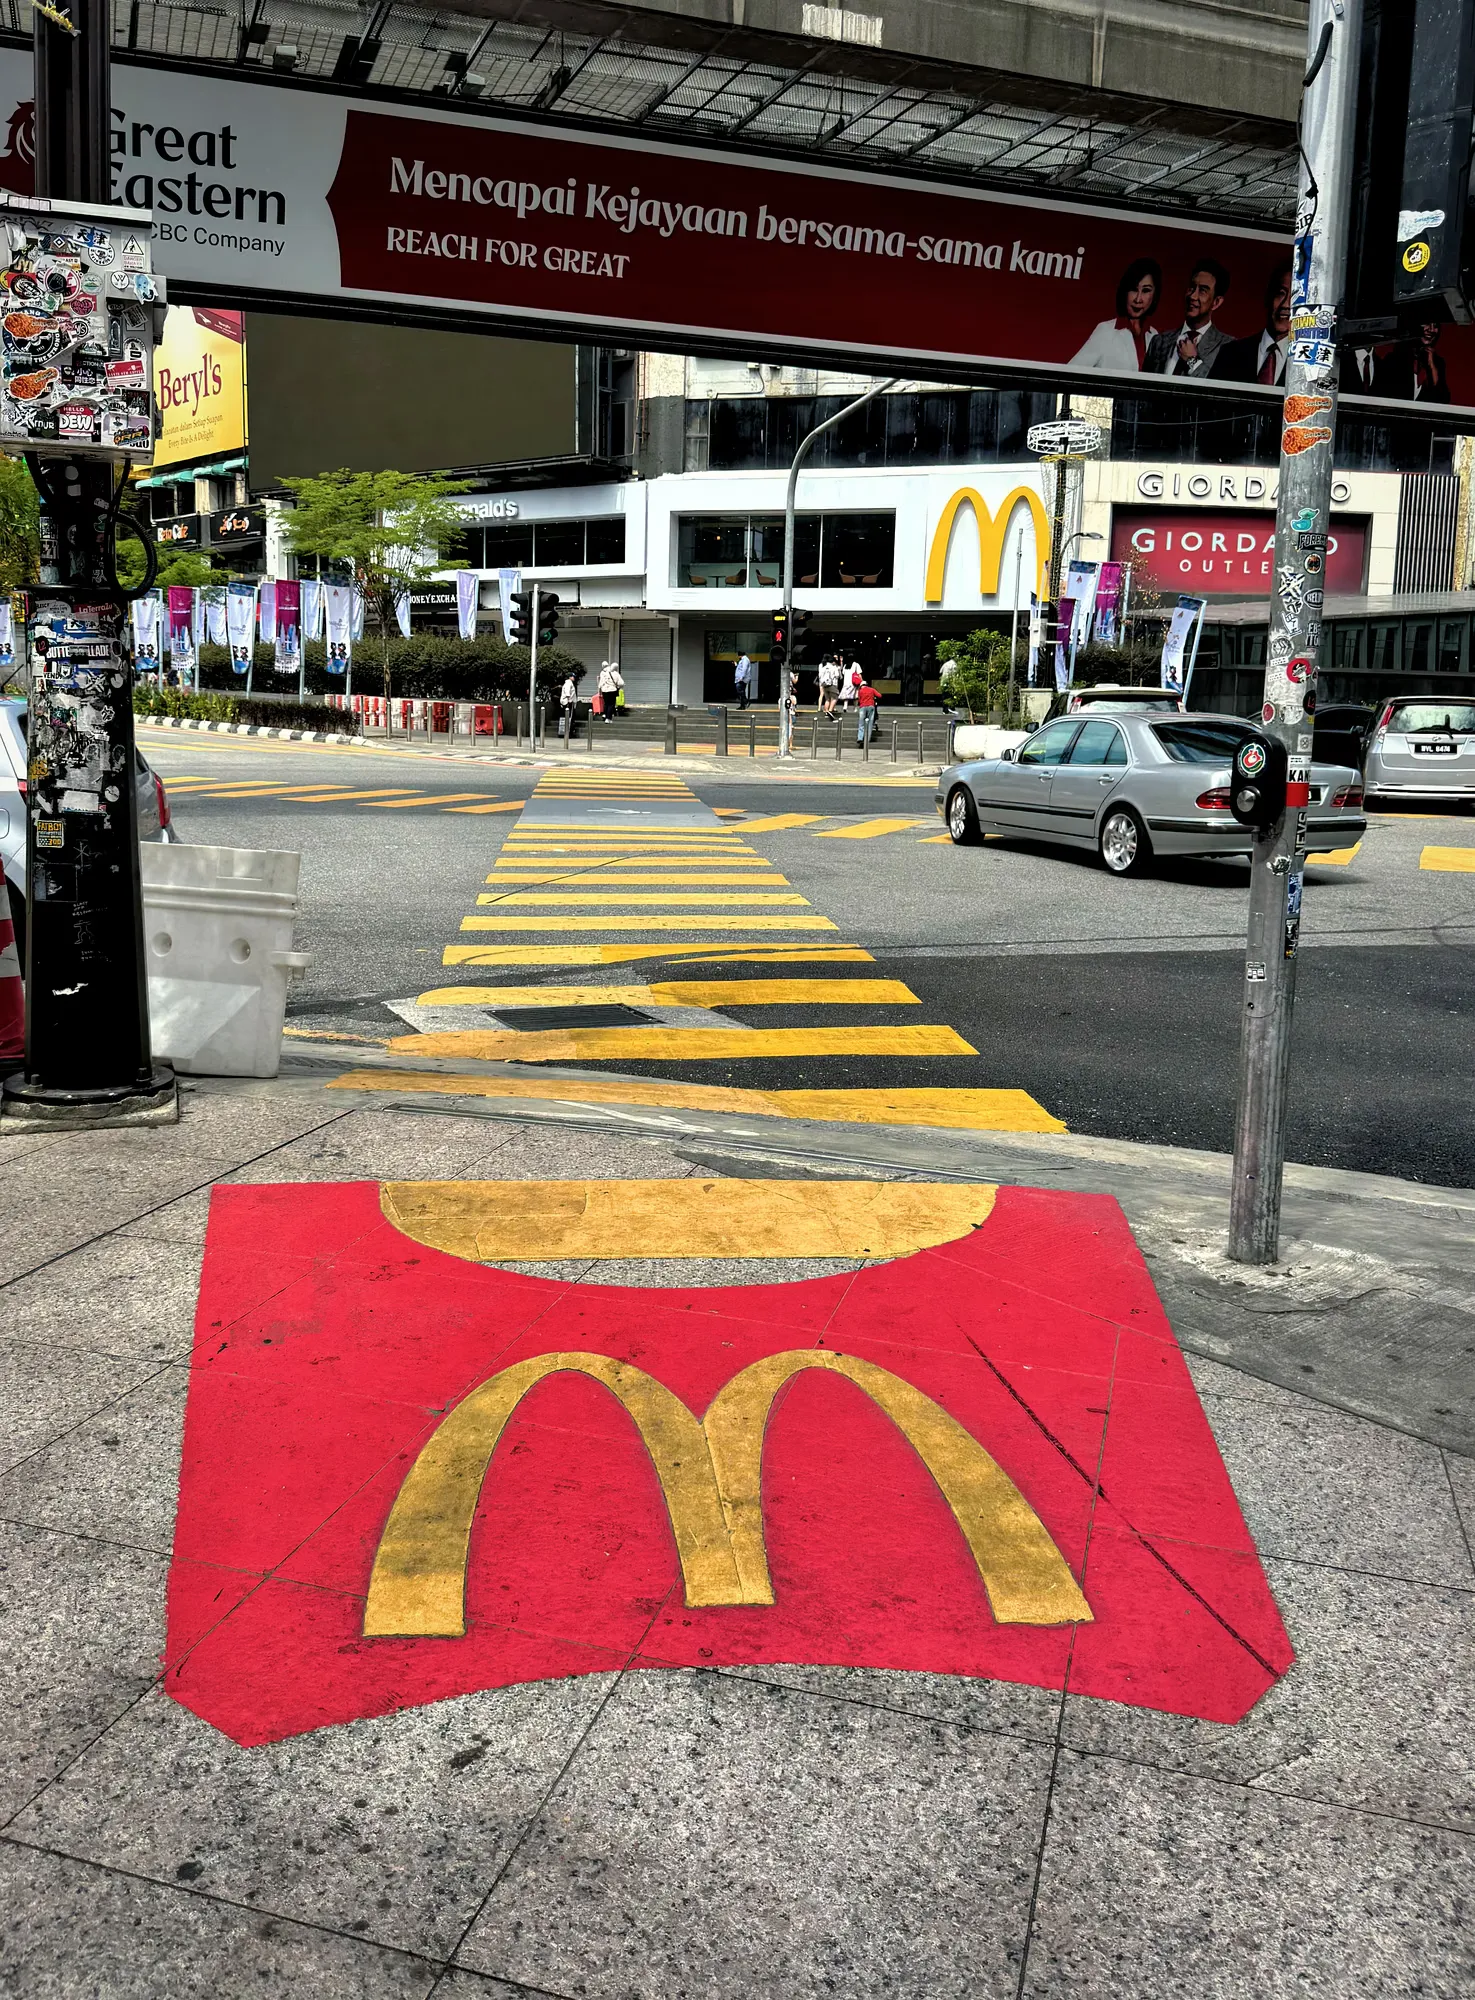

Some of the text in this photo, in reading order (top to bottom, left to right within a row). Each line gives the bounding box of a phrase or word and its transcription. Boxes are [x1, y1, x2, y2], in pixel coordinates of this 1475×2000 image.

[389, 156, 1086, 280] Mencapai Kejayaan bersama-sama kami
[193, 227, 286, 257] Company
[386, 226, 631, 279] REACH FOR GREAT
[158, 352, 222, 417] Beryl's
[1138, 470, 1351, 502] GIORDO
[1131, 528, 1338, 556] GIORDAO
[1179, 559, 1269, 575] OUTLE
